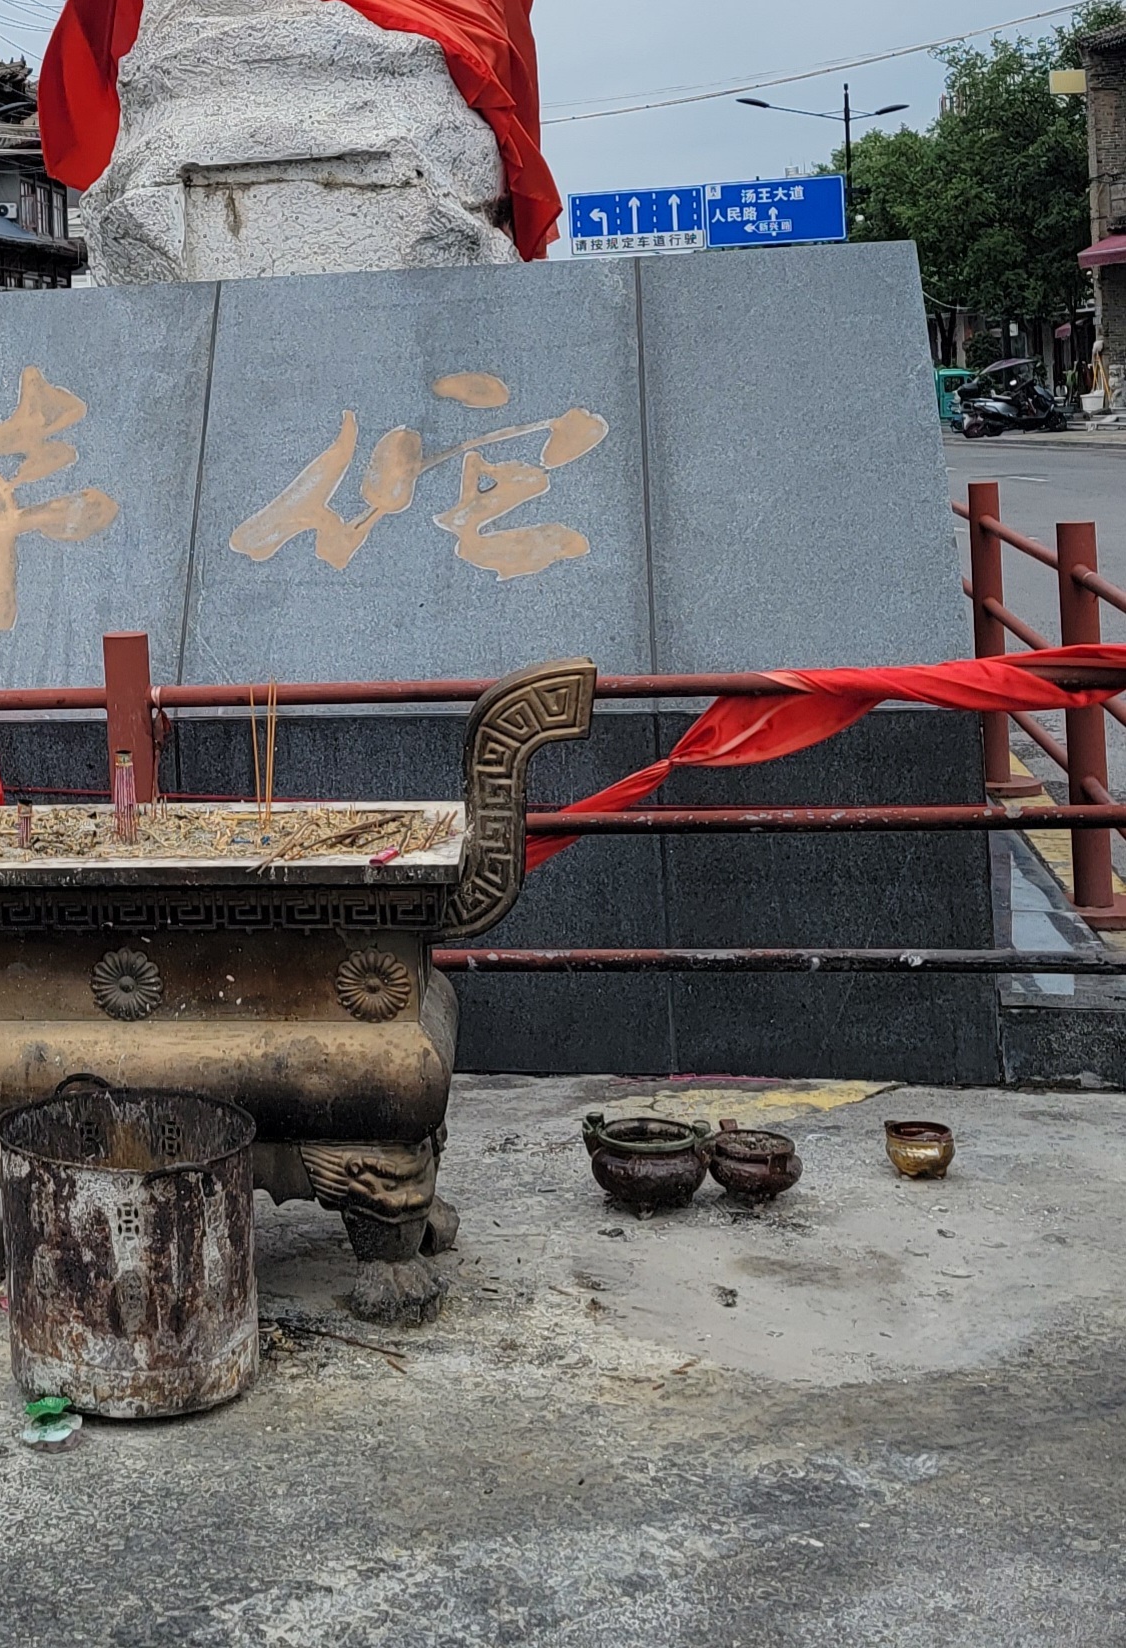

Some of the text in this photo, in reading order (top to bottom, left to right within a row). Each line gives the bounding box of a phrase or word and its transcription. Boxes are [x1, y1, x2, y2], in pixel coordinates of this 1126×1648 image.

[741, 185, 805, 204] 汤王大道
[711, 206, 758, 224] 人民路
[574, 232, 698, 252] 请按规定车道行驶
